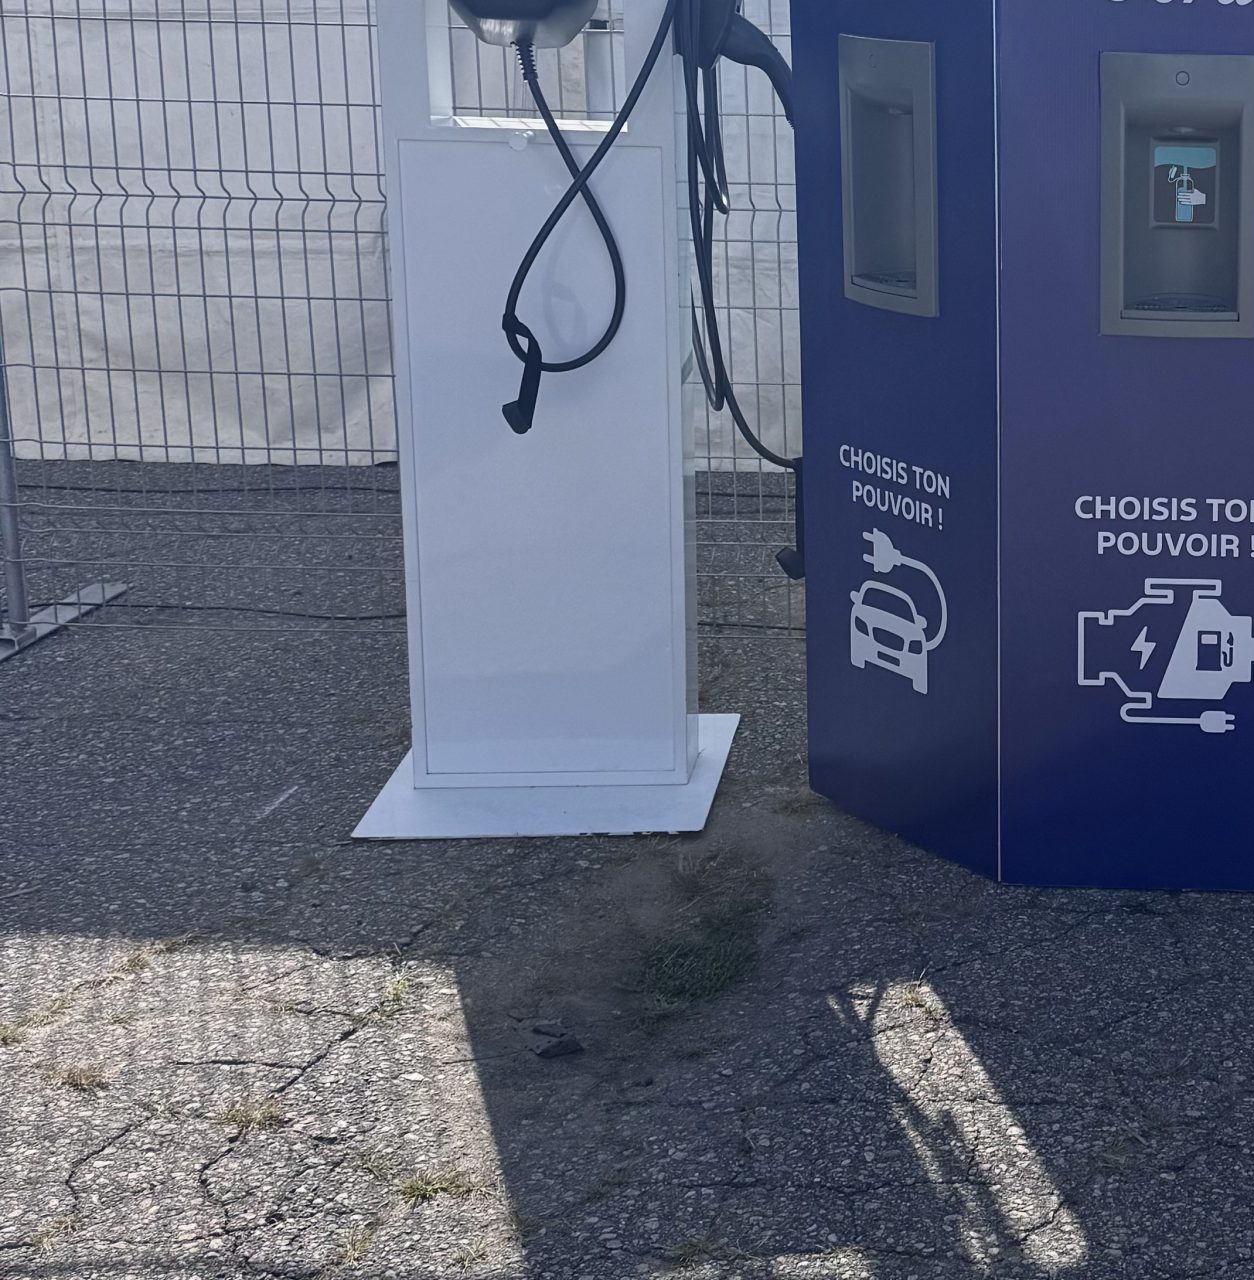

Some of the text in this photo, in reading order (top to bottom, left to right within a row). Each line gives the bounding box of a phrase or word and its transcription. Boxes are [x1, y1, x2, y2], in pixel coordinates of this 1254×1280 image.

[838, 443, 951, 500] CHOISIS TON
[851, 480, 944, 531] POUVOIR !
[1074, 495, 1198, 522] CHOISIS
[1096, 531, 1241, 558] POUVOIR
